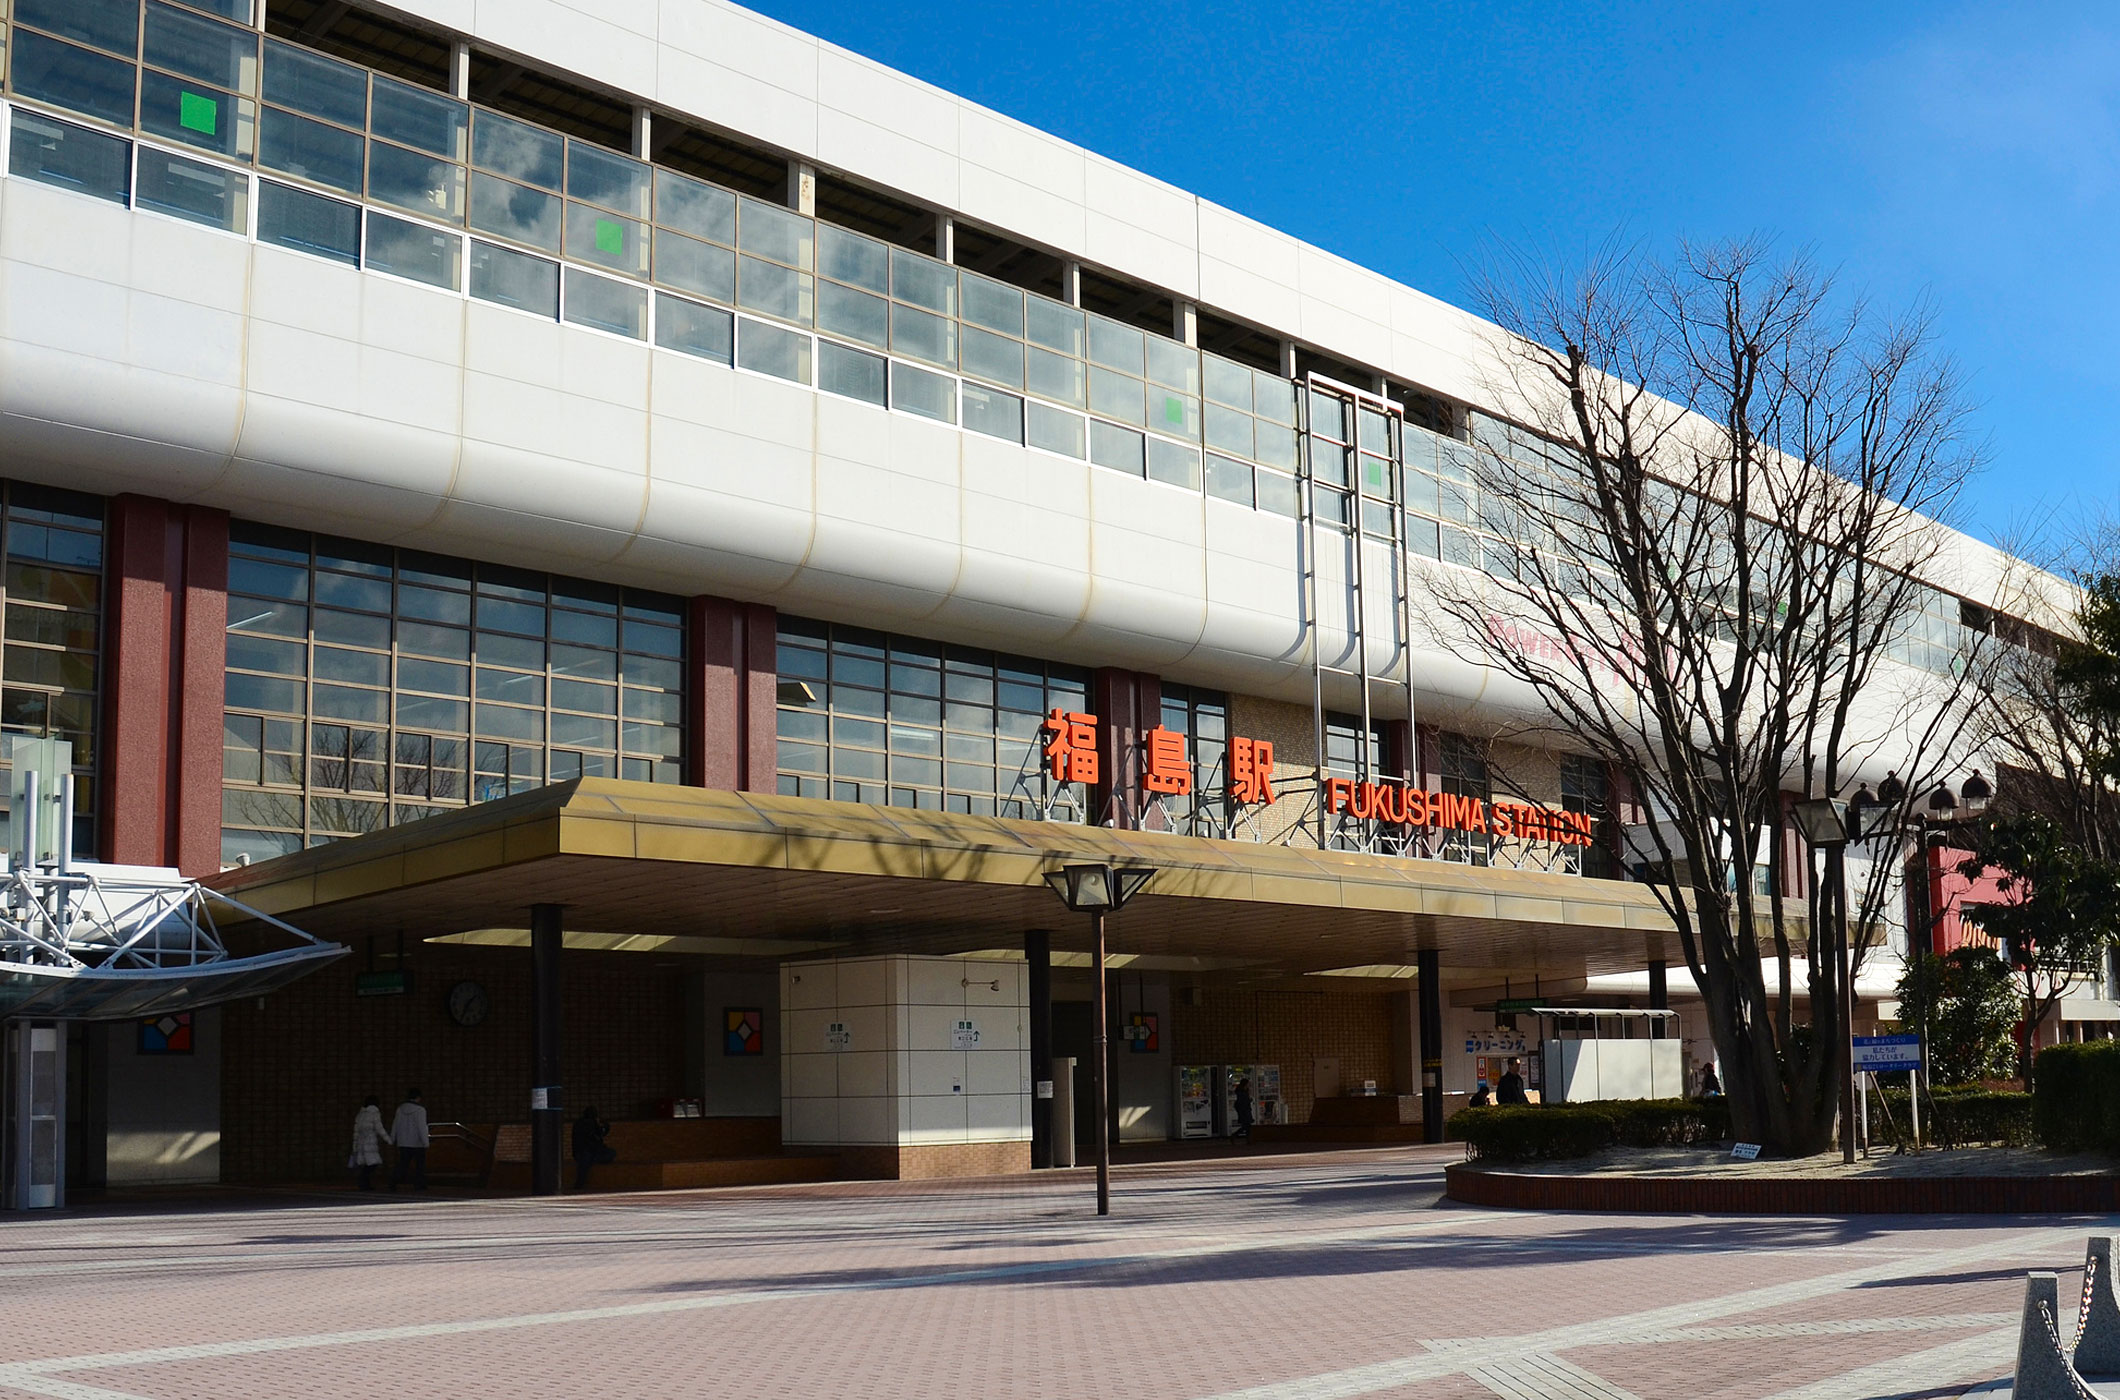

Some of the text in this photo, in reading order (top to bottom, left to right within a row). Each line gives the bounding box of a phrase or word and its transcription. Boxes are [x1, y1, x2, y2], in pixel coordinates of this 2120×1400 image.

[1044, 708, 1275, 804] 福島駅
[1325, 777, 1592, 847] FUKUSHIMA STATION
[1475, 1039, 1524, 1050] クリーニング
